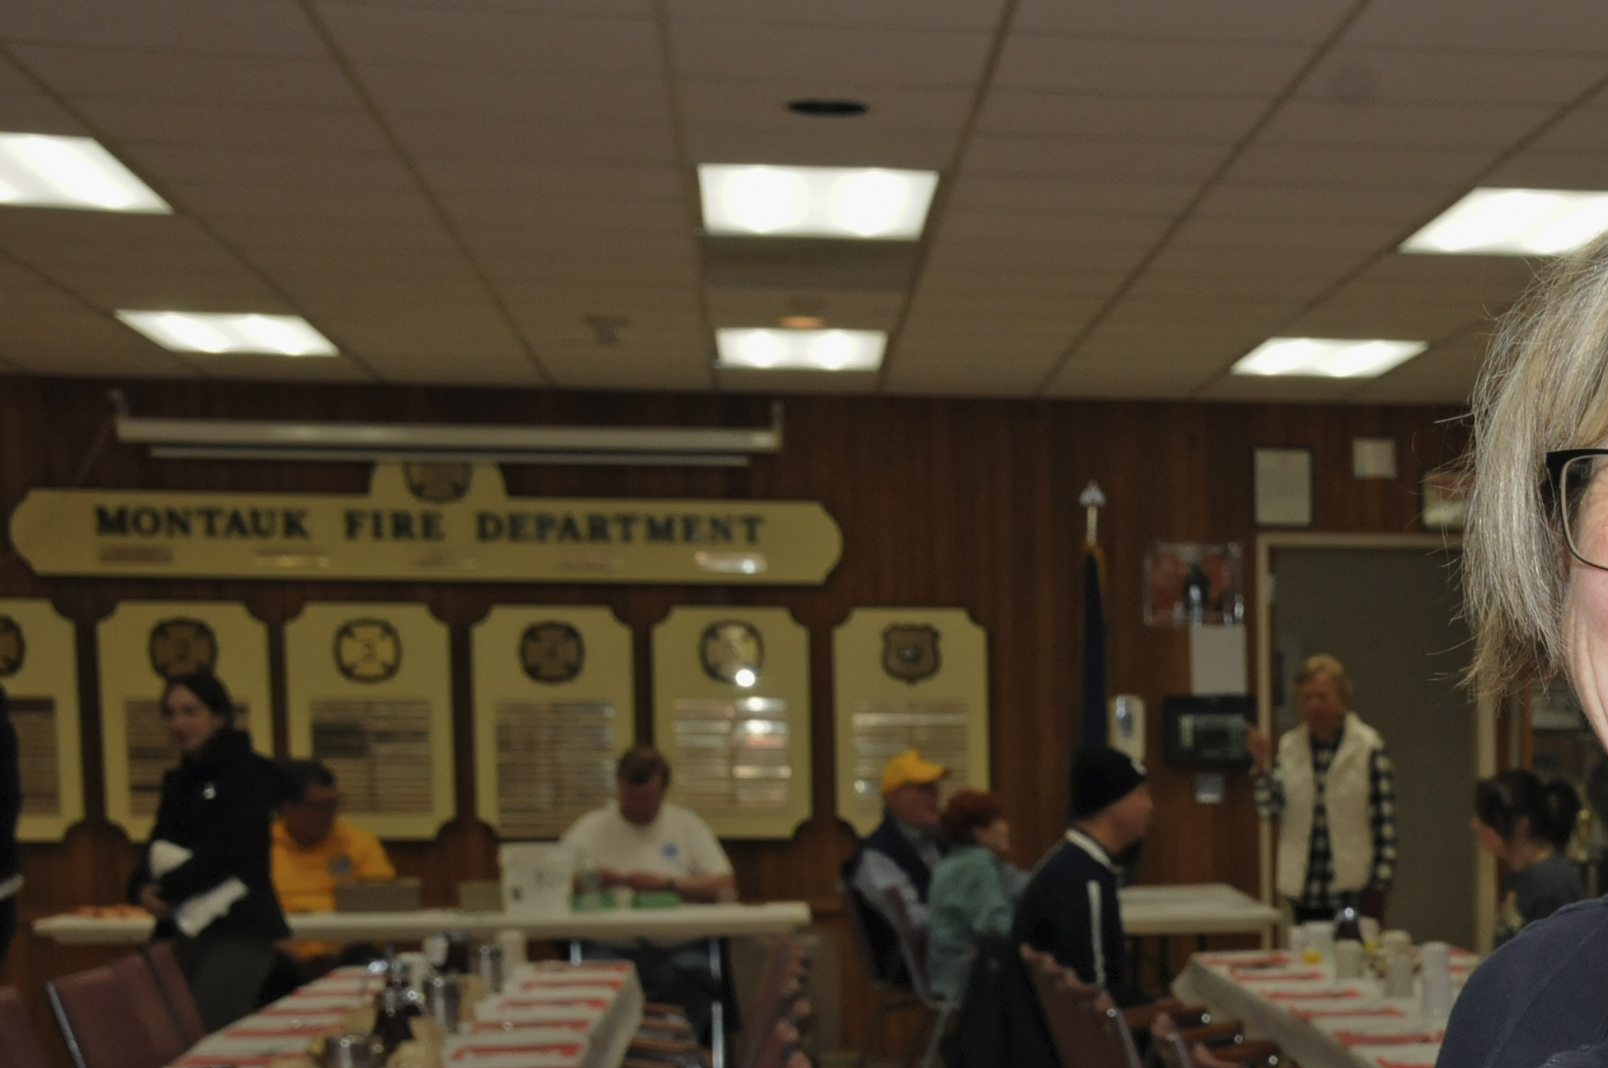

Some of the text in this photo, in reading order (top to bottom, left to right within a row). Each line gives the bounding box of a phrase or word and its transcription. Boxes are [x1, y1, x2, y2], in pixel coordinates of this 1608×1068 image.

[96, 504, 766, 545] MONTAUK FIRE DEPARTMENT
